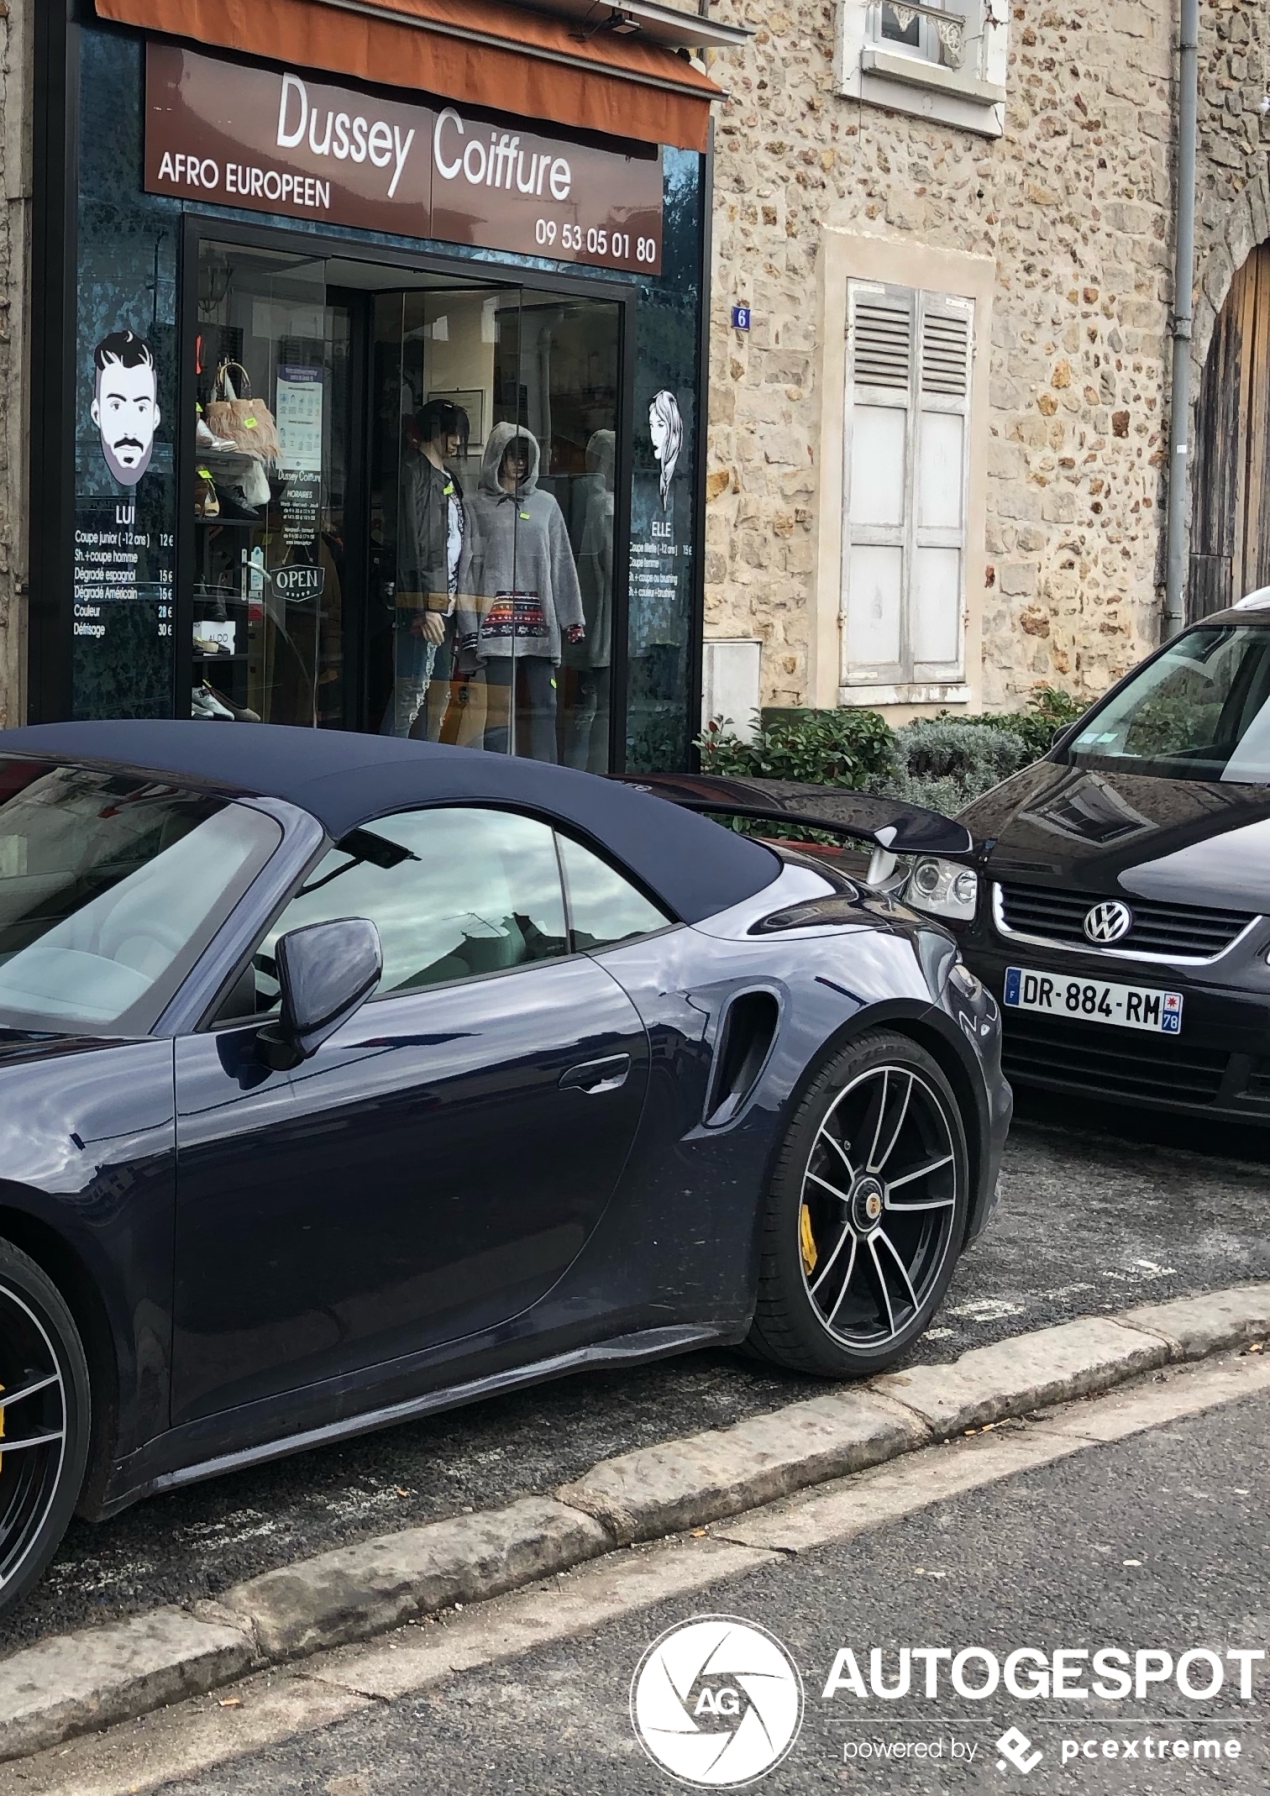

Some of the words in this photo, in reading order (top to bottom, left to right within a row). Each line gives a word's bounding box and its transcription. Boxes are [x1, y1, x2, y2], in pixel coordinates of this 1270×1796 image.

[277, 72, 415, 198] Dussey
[434, 107, 571, 200] Coiffure
[158, 152, 219, 188] AFRO
[226, 163, 330, 209] EUROPEEN
[535, 219, 556, 246] 09
[561, 224, 582, 250] 53
[587, 228, 607, 255] 05
[612, 232, 629, 258] 01
[636, 237, 656, 263] 80
[737, 309, 746, 327] 6
[116, 504, 135, 525] LUI
[652, 521, 671, 537] ELLE
[75, 530, 98, 546] Coupe
[113, 550, 138, 563] homme
[74, 566, 104, 583] Dégradé
[105, 569, 136, 583] espagnol
[276, 570, 318, 589] OPEN
[74, 585, 104, 601] Dégradé
[74, 604, 101, 617] Couleur
[73, 622, 106, 638] Défrisage
[1009, 990, 1016, 999] F
[1023, 975, 1161, 1026] DR-884-RM
[1163, 1014, 1178, 1030] 78
